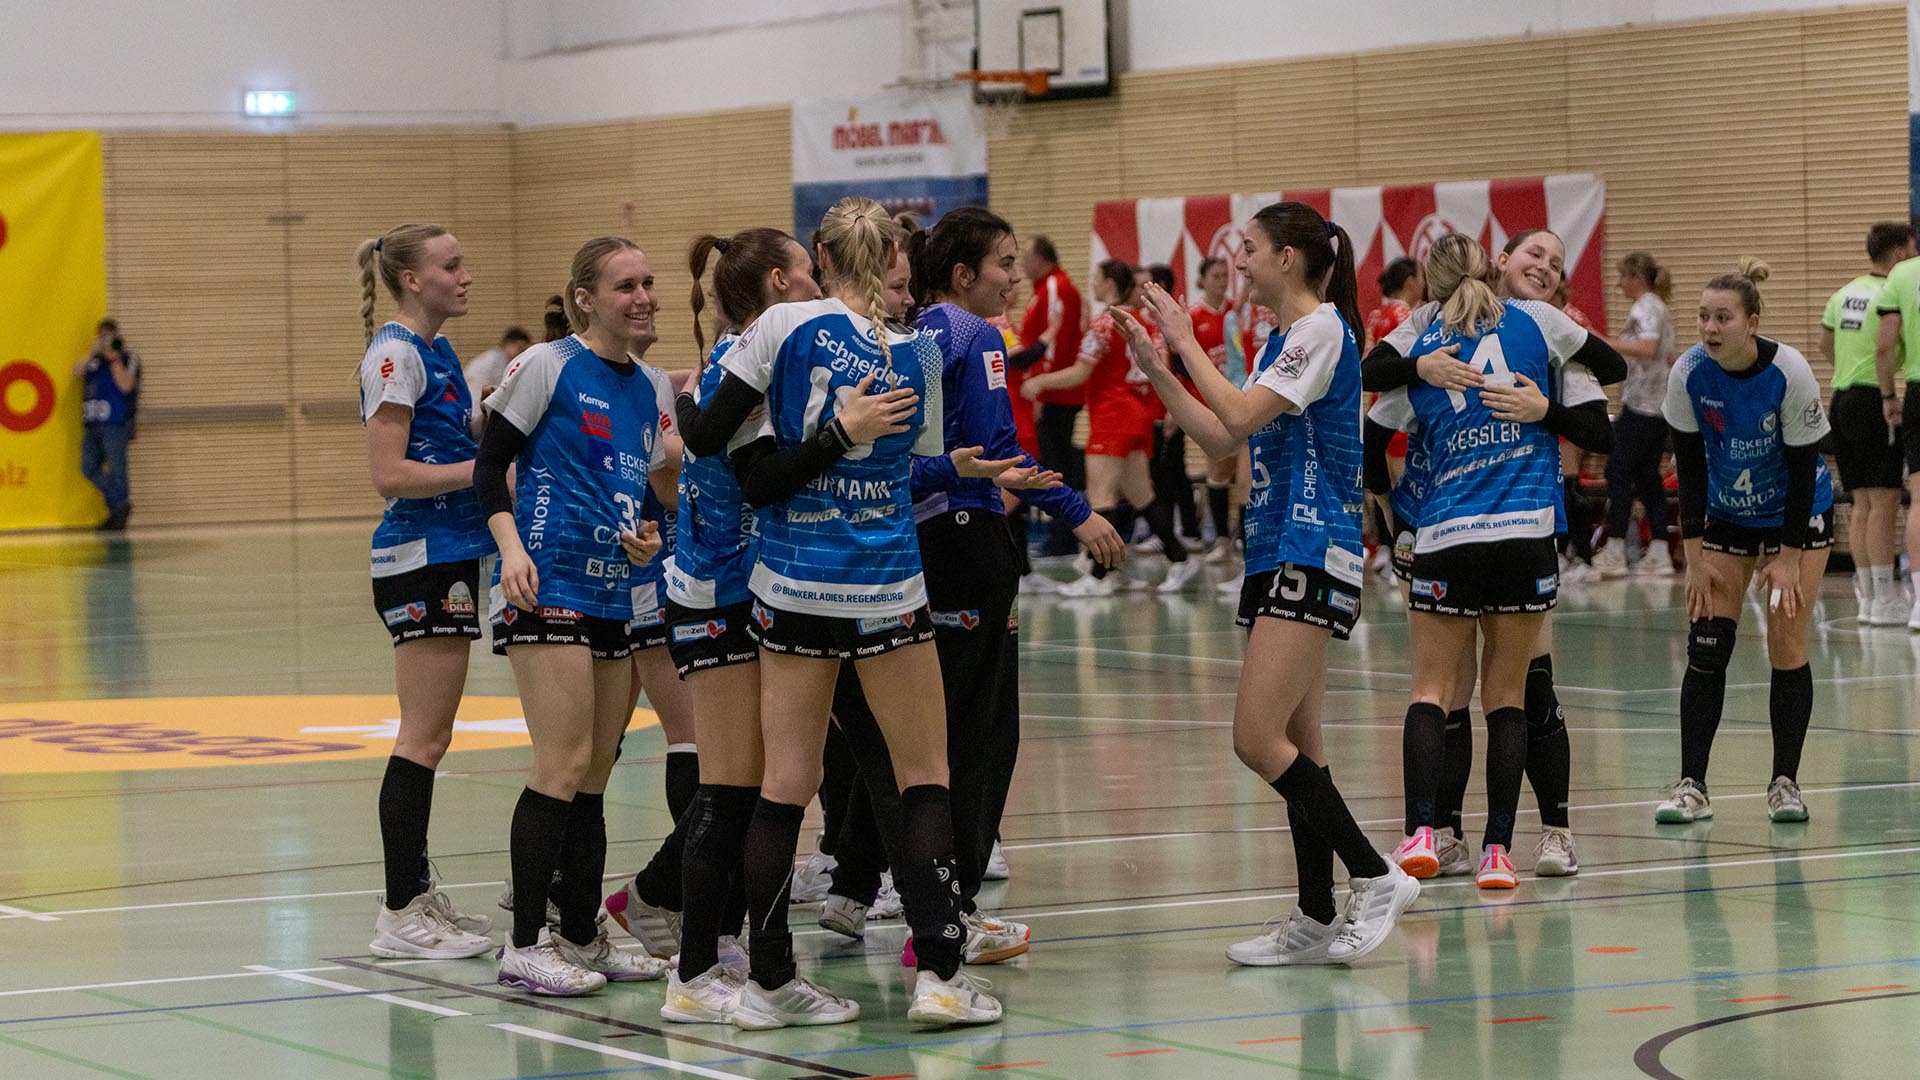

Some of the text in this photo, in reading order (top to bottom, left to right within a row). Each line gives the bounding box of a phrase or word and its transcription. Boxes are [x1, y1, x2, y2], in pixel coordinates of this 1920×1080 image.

[578, 392, 610, 410] Kempa
[1303, 460, 1318, 500] CHIPS
[1732, 467, 1753, 496] 4
[528, 484, 550, 550] KRONES
[771, 582, 904, 604] @BUNKERLADIES.REGENSBURG
[1270, 606, 1297, 618] Kempa
[1303, 612, 1328, 626] Kempa
[403, 629, 425, 638] Kempa
[512, 633, 538, 642] Kempa
[546, 633, 574, 642] Kempa
[763, 638, 787, 652] Kempa
[794, 645, 822, 657] Kempa
[856, 643, 885, 656] Kempa
[693, 655, 719, 669] Kempa
[727, 650, 756, 663] Kempa
